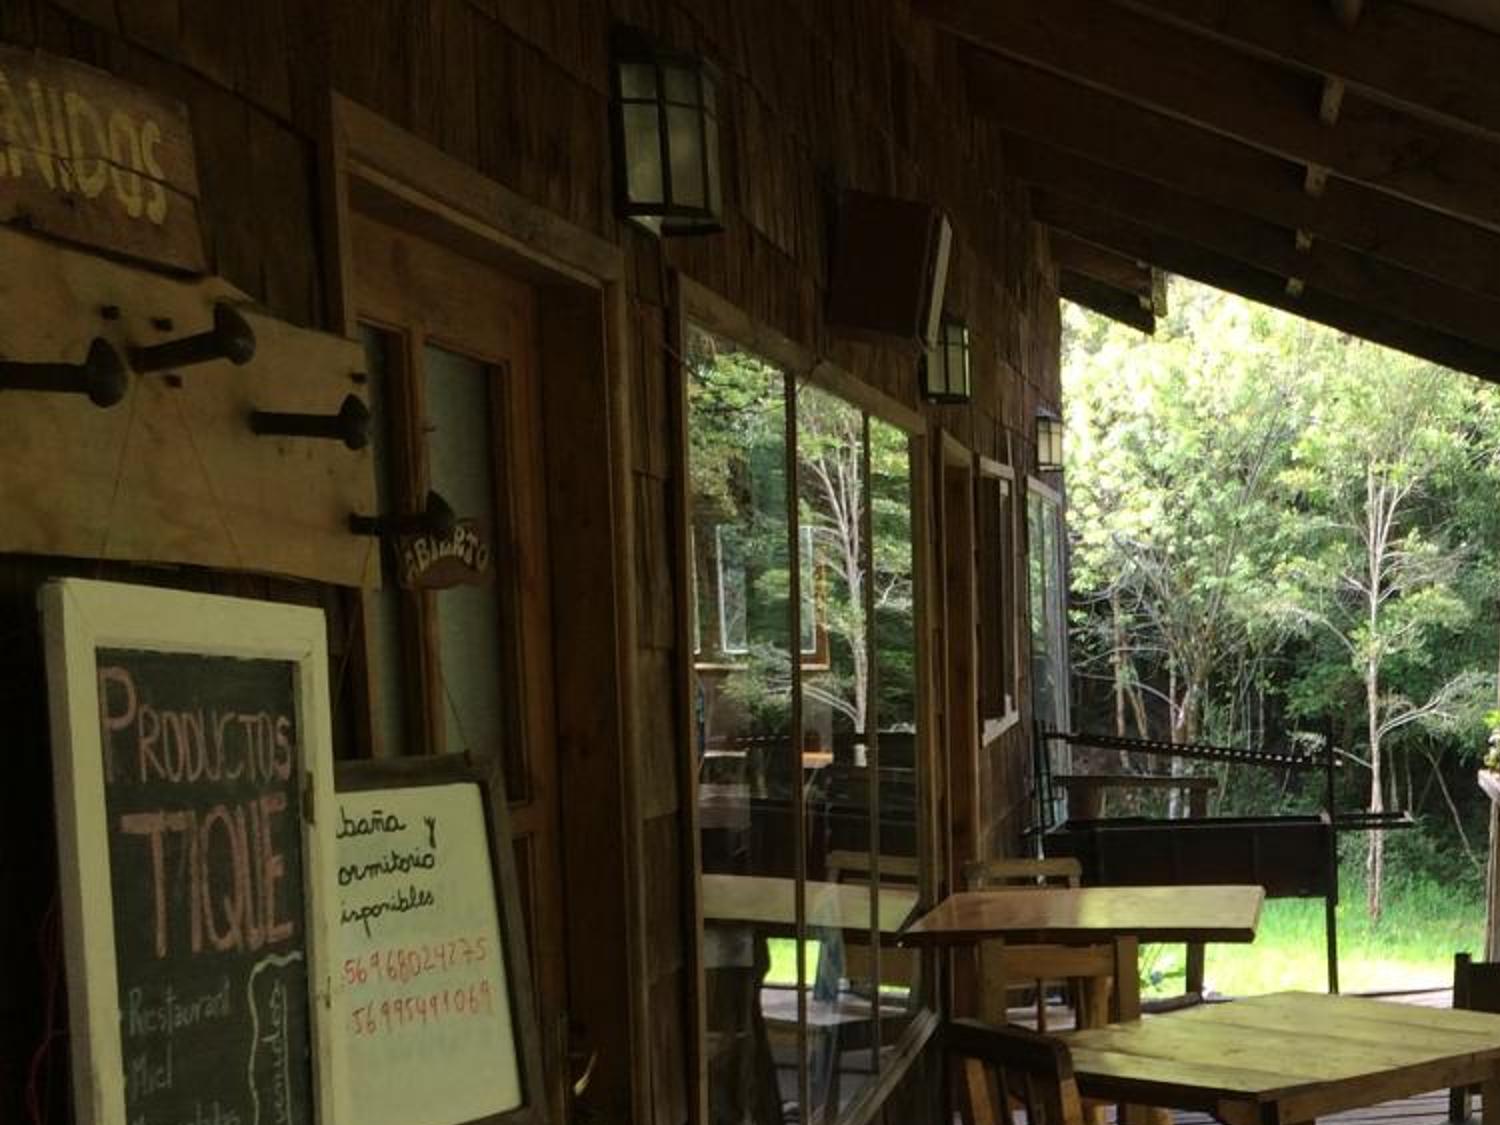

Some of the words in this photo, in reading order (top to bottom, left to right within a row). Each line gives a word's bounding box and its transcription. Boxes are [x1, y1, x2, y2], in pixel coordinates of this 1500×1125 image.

[0, 64, 168, 225] NIDOS
[97, 664, 293, 785] PRODUCTOS
[117, 790, 295, 960] TIQUE
